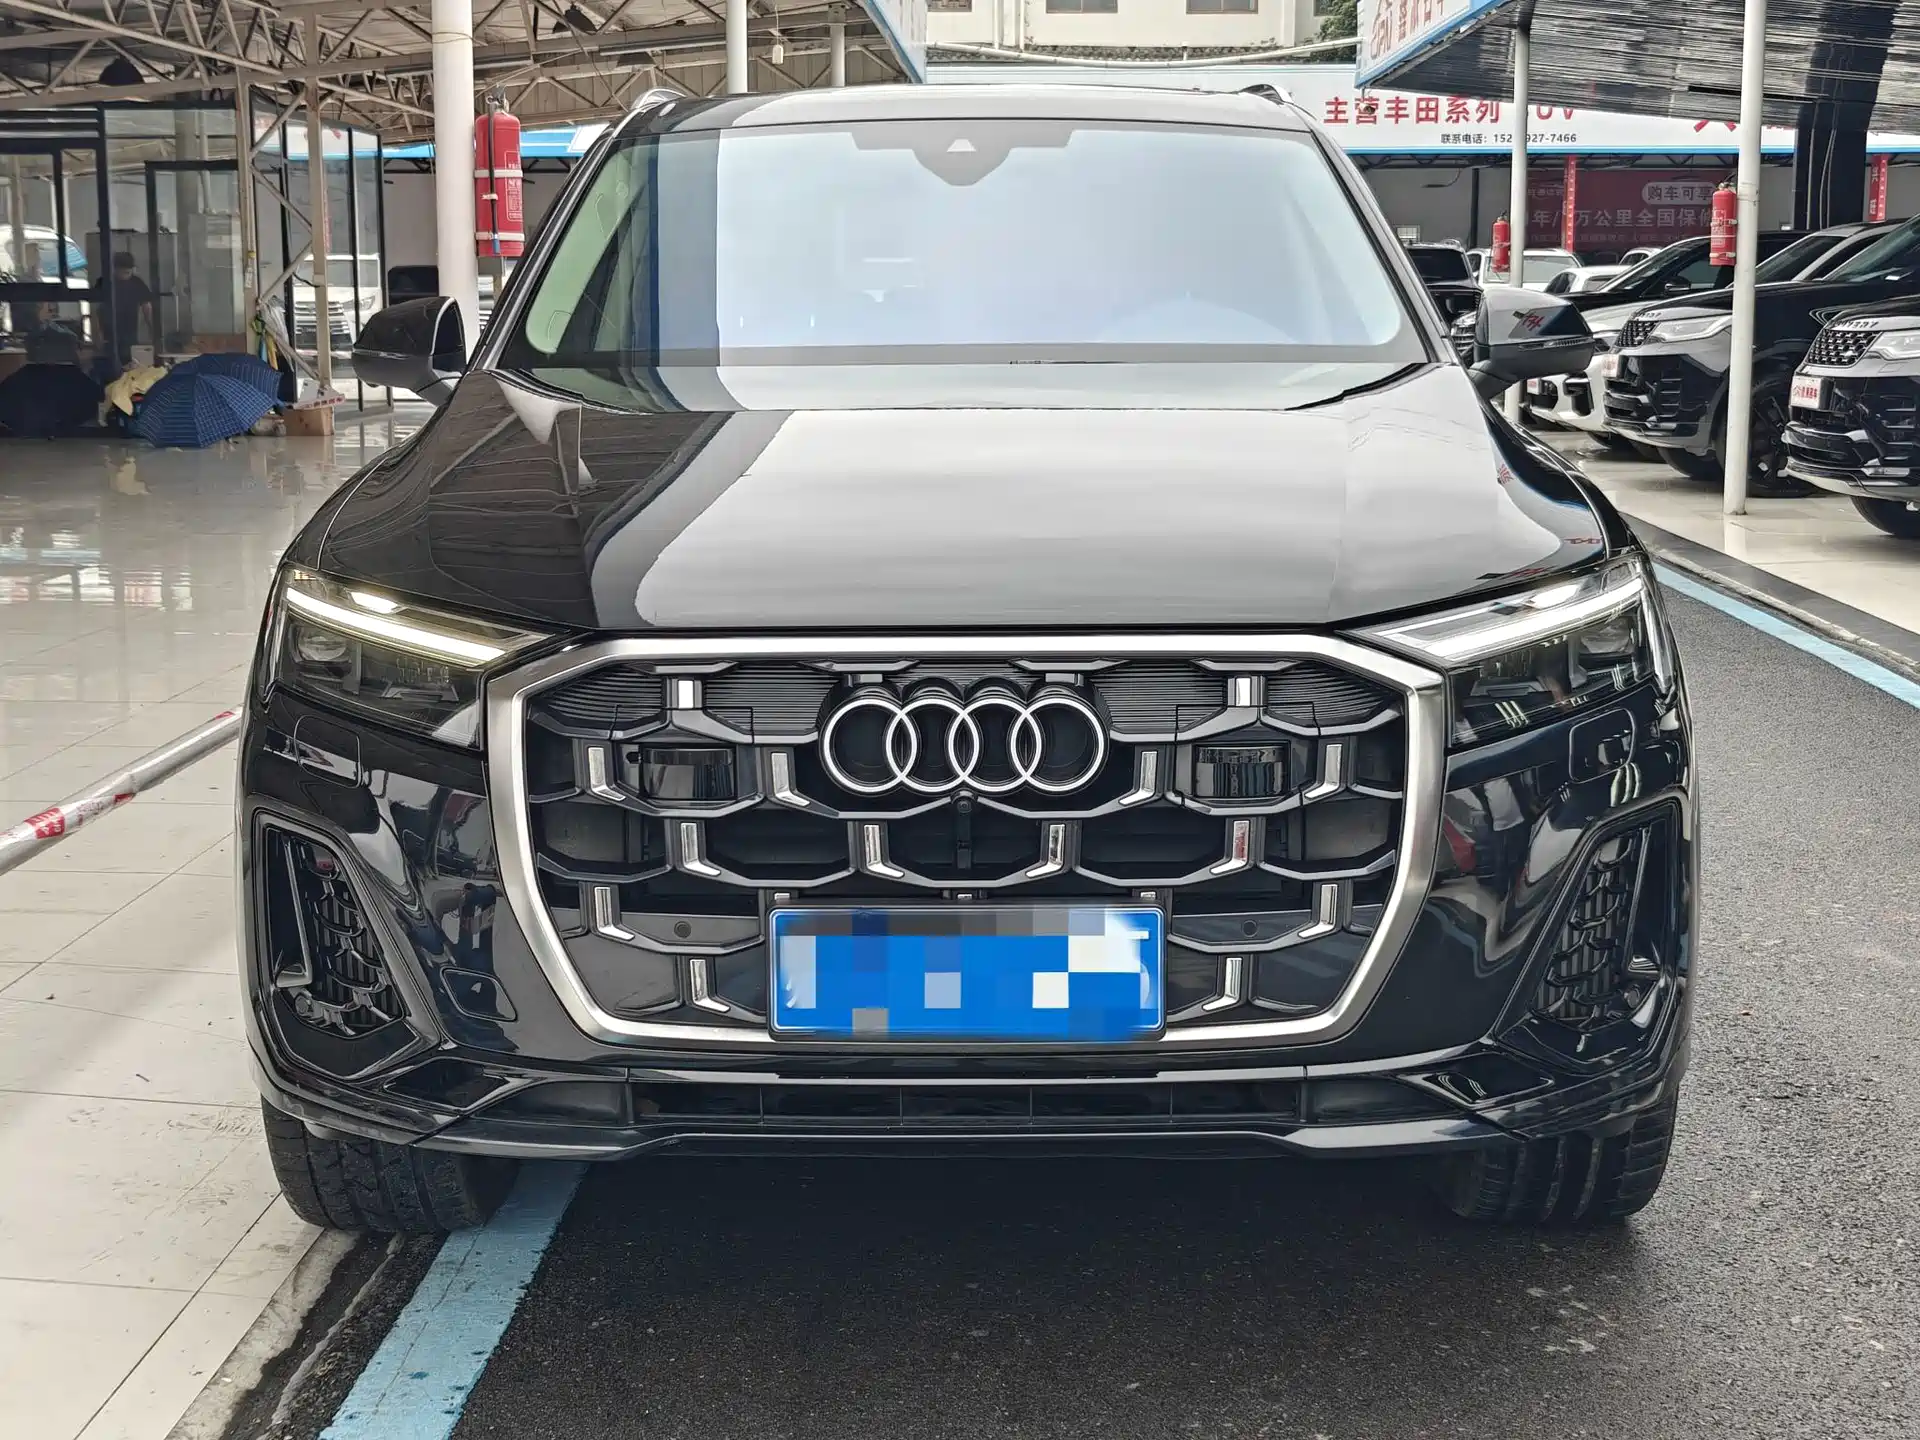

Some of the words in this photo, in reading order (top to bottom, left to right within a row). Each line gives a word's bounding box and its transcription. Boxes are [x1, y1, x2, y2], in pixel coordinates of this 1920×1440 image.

[1323, 96, 1574, 125] 主营丰田系列UV
